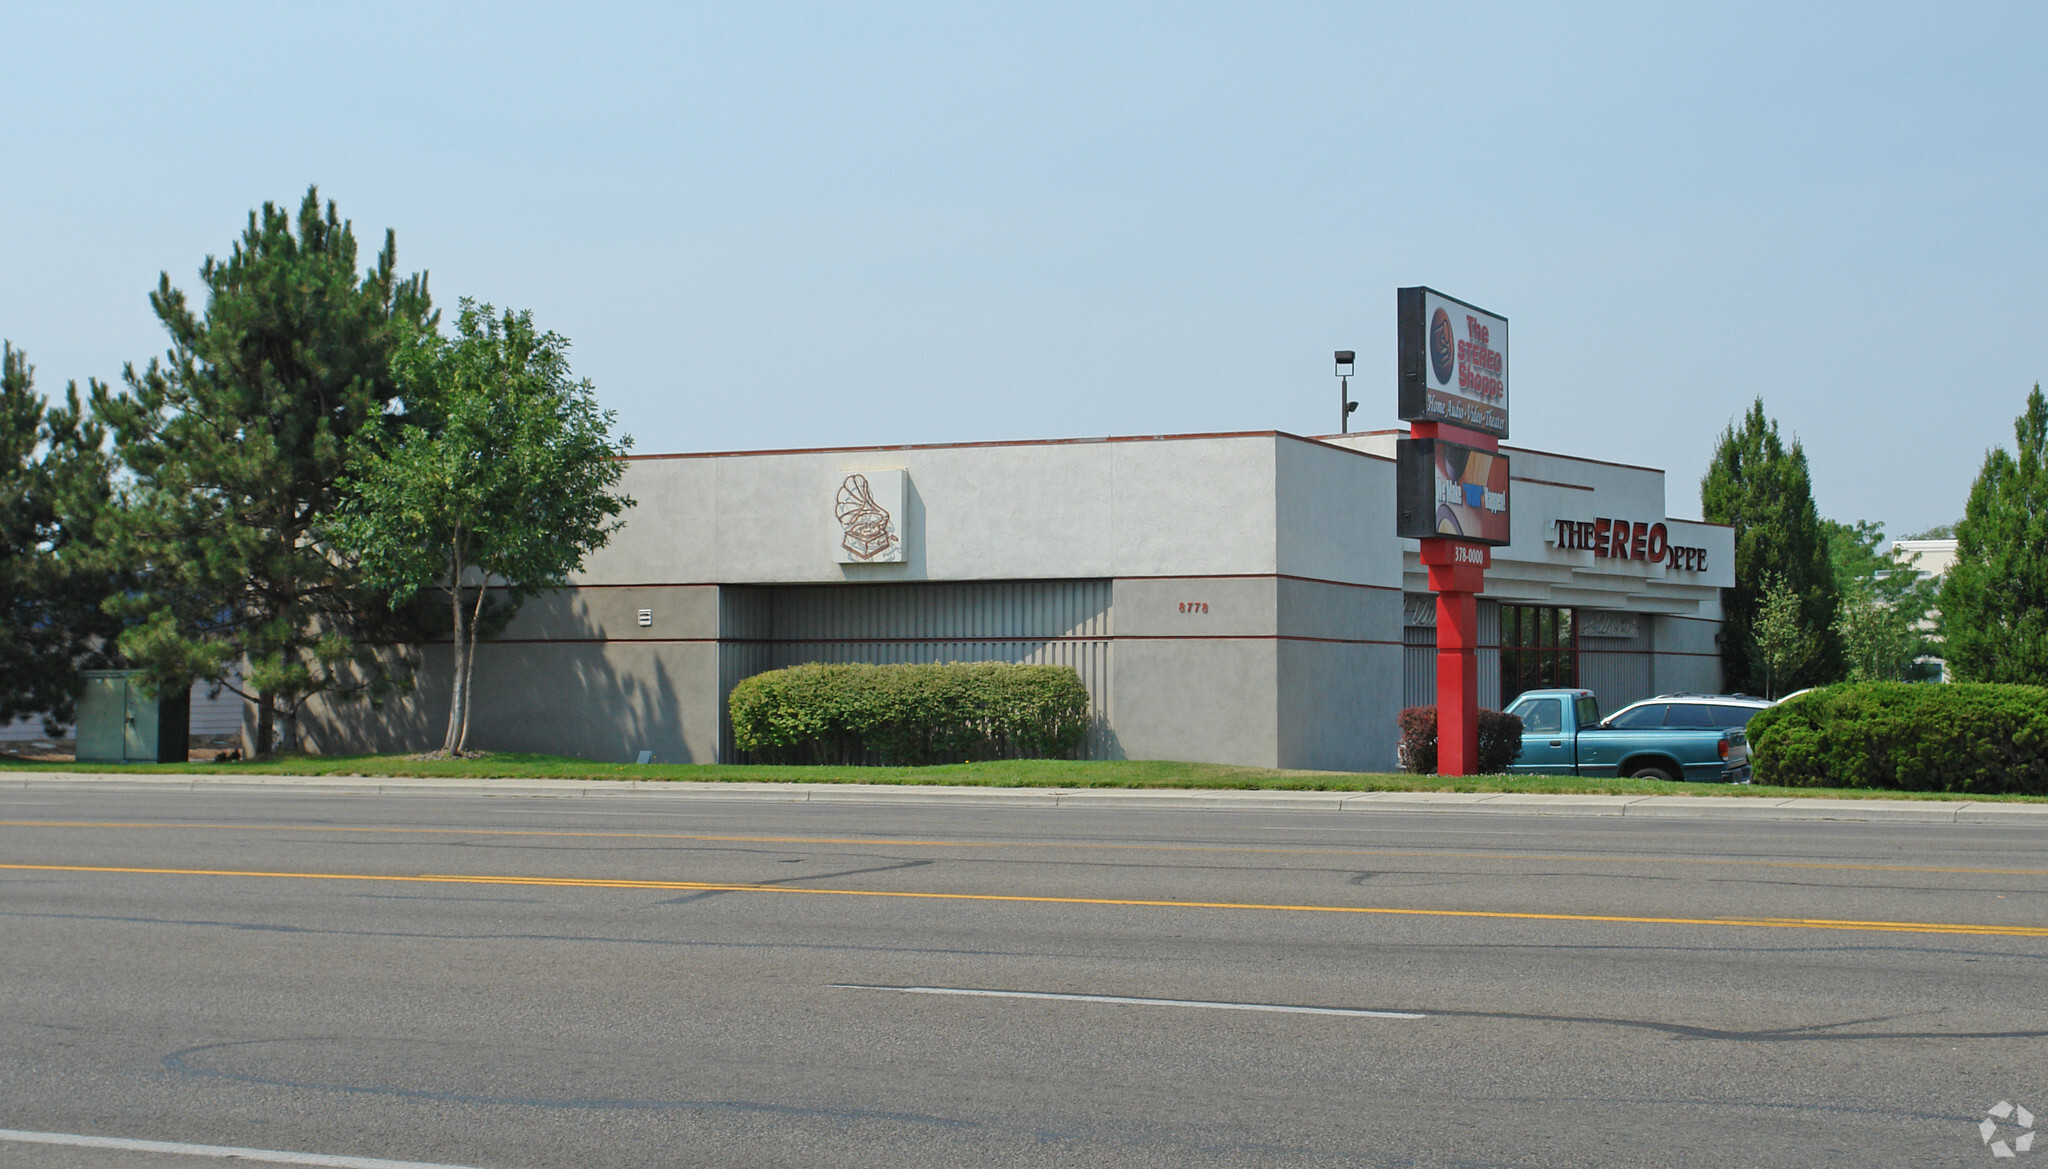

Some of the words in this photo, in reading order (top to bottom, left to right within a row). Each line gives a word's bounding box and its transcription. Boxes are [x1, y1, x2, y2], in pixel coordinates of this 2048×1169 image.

[1466, 314, 1489, 343] The
[1457, 339, 1502, 374] STEREO
[1458, 363, 1504, 400] Shoppe
[1427, 394, 1446, 415] Home
[1445, 400, 1464, 419] Audio
[1467, 404, 1482, 425] Video
[1446, 479, 1462, 505] Make
[1554, 519, 1595, 551] THE
[1455, 546, 1483, 565] 378-0000
[1178, 602, 1209, 614] 8778
